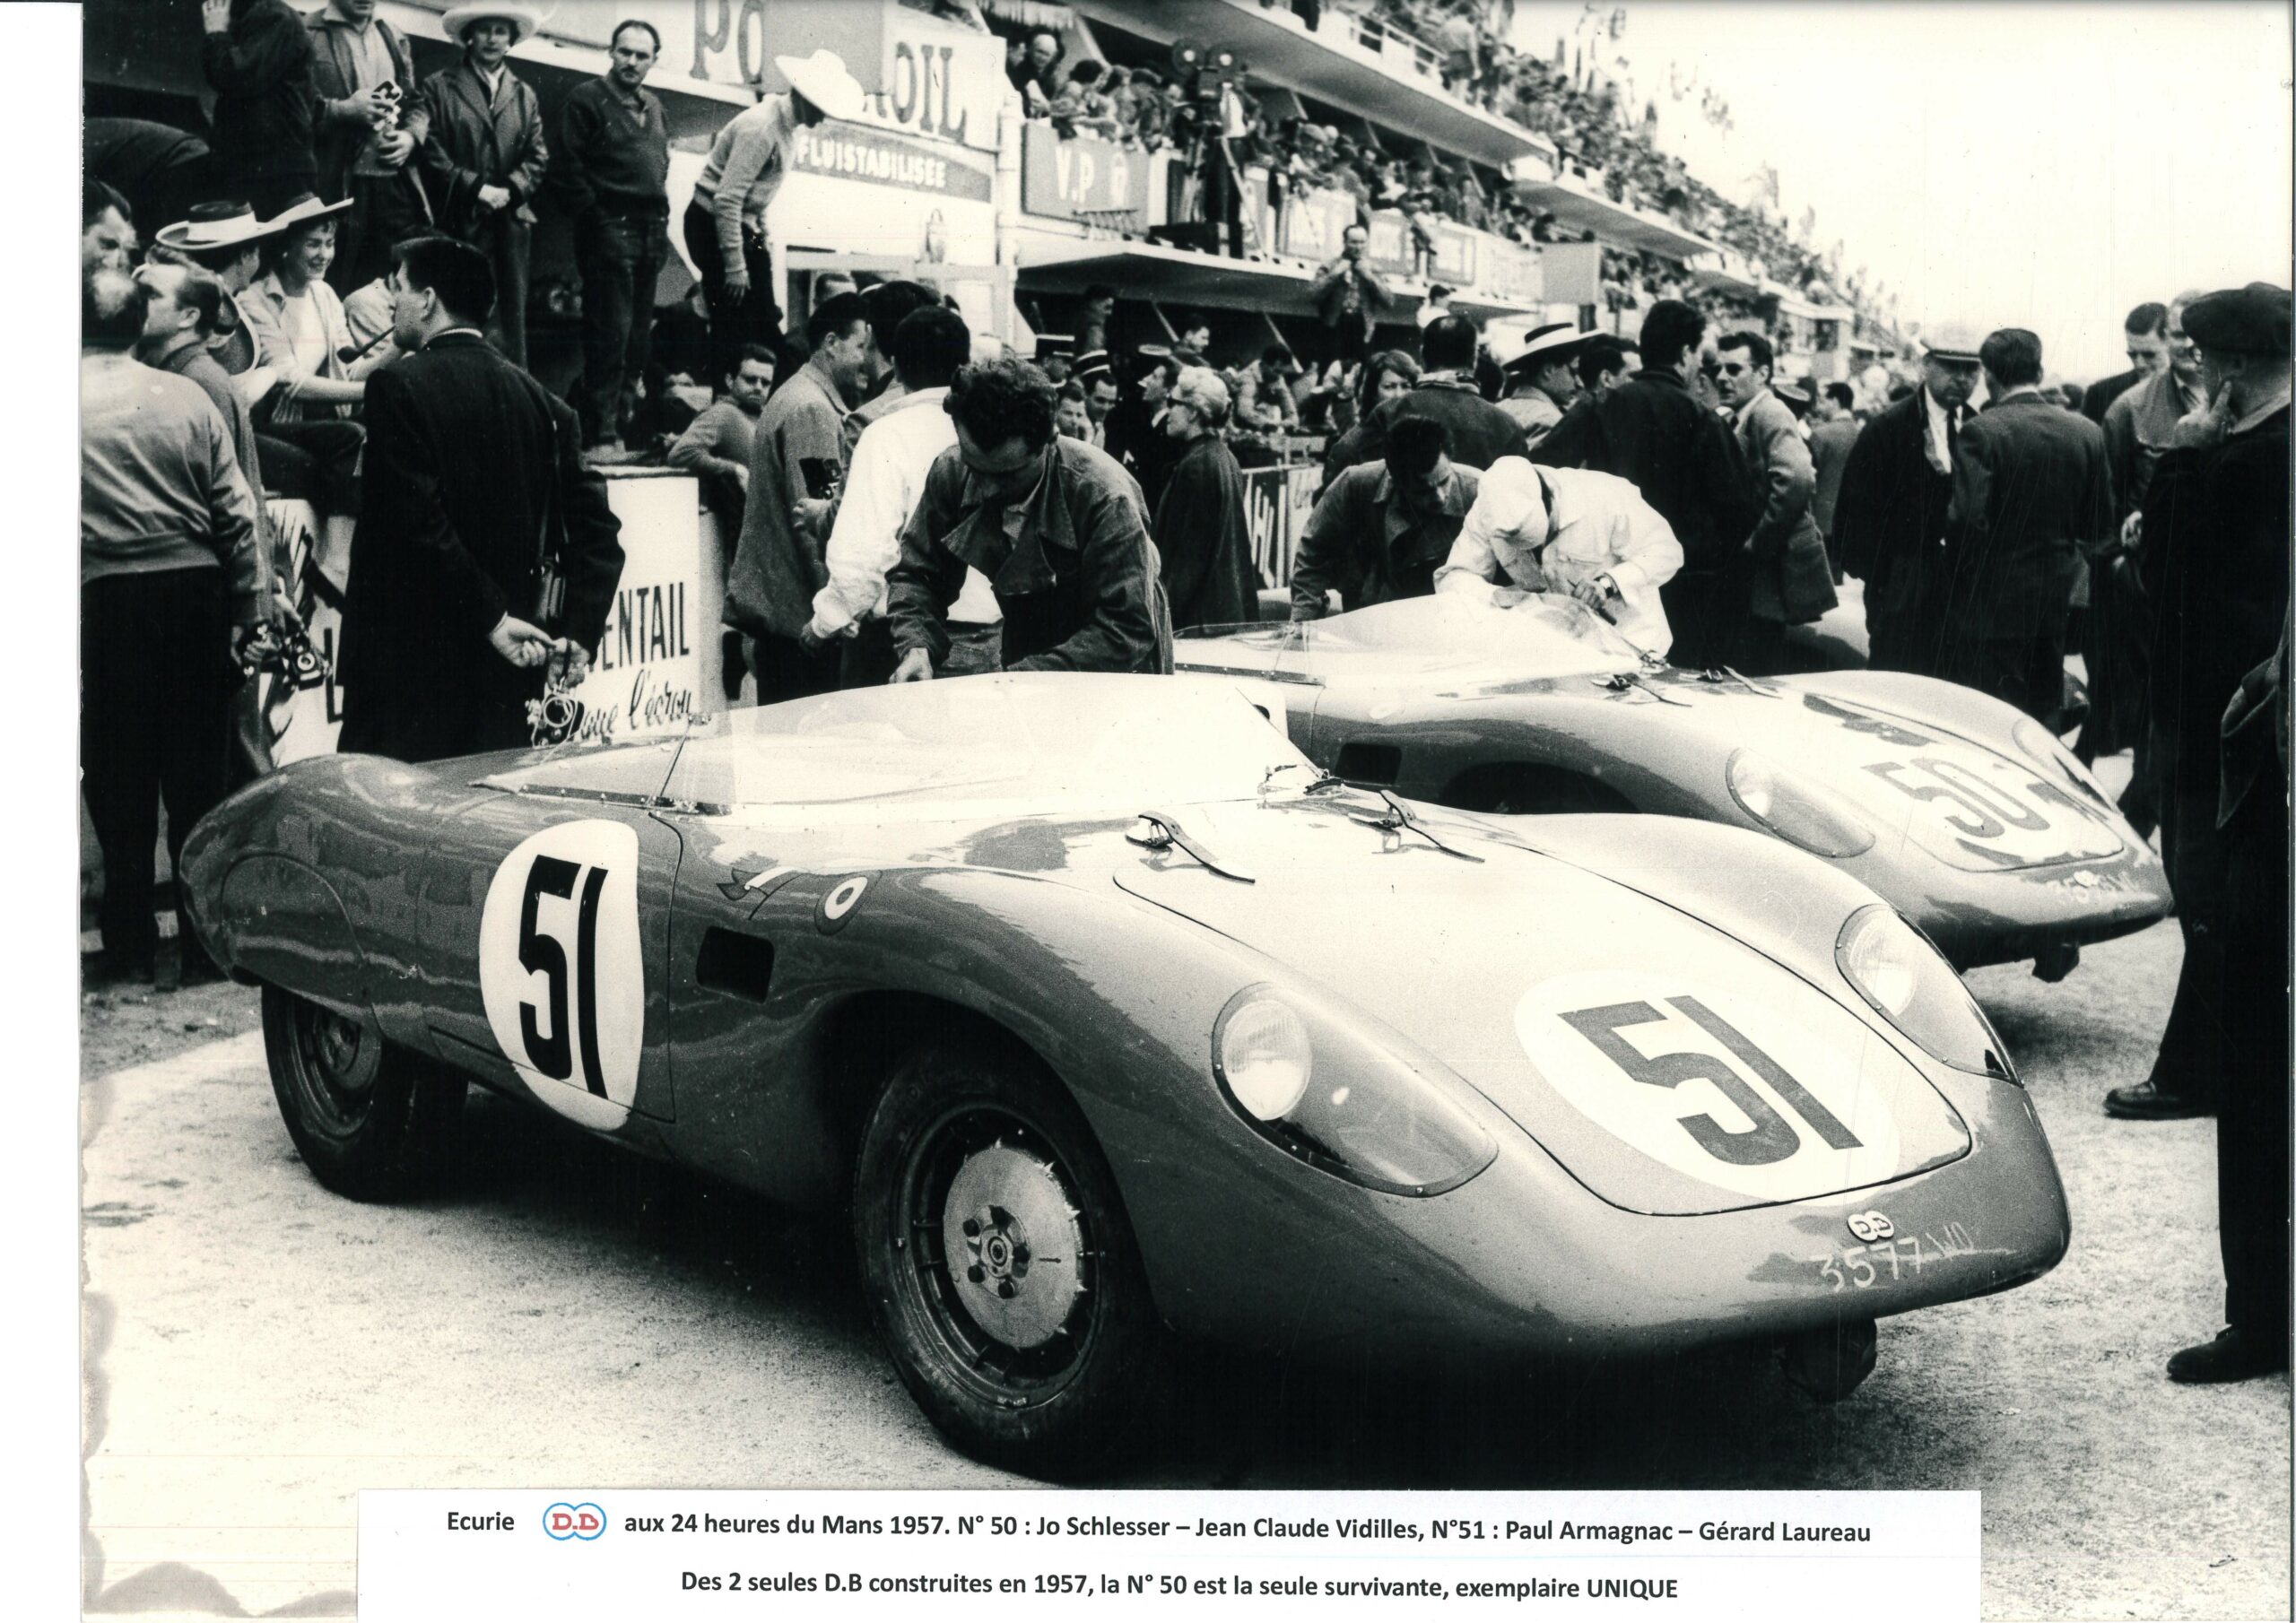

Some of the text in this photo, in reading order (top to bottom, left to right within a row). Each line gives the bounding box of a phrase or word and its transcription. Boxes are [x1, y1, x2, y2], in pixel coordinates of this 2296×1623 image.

[589, 582, 690, 673] ENTAIL
[1860, 757, 2050, 839] 50
[518, 854, 609, 1100] 51
[1556, 994, 1865, 1166] 51
[1808, 1236, 1921, 1292] 3577
